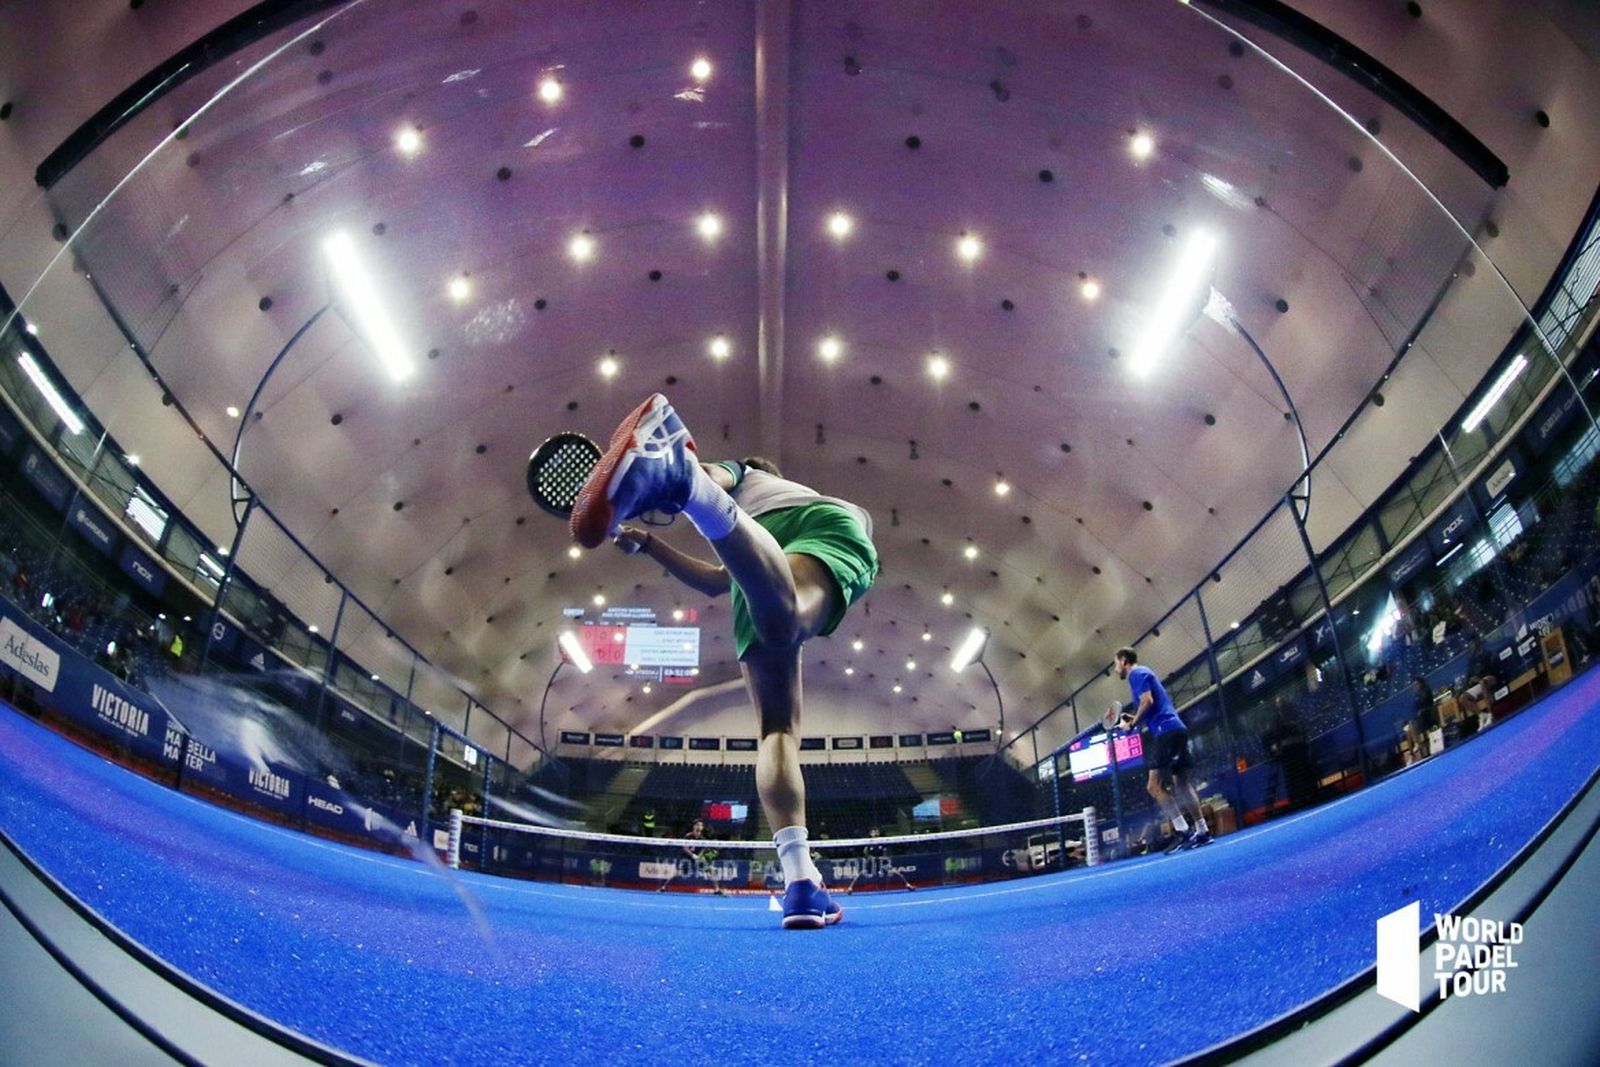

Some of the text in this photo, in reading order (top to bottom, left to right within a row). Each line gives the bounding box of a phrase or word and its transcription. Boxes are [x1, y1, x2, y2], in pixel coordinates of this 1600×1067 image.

[4, 635, 49, 677] Adeslas
[92, 683, 149, 736] VICTORIA
[248, 767, 290, 798] VICTORIA
[308, 795, 343, 815] HEAD
